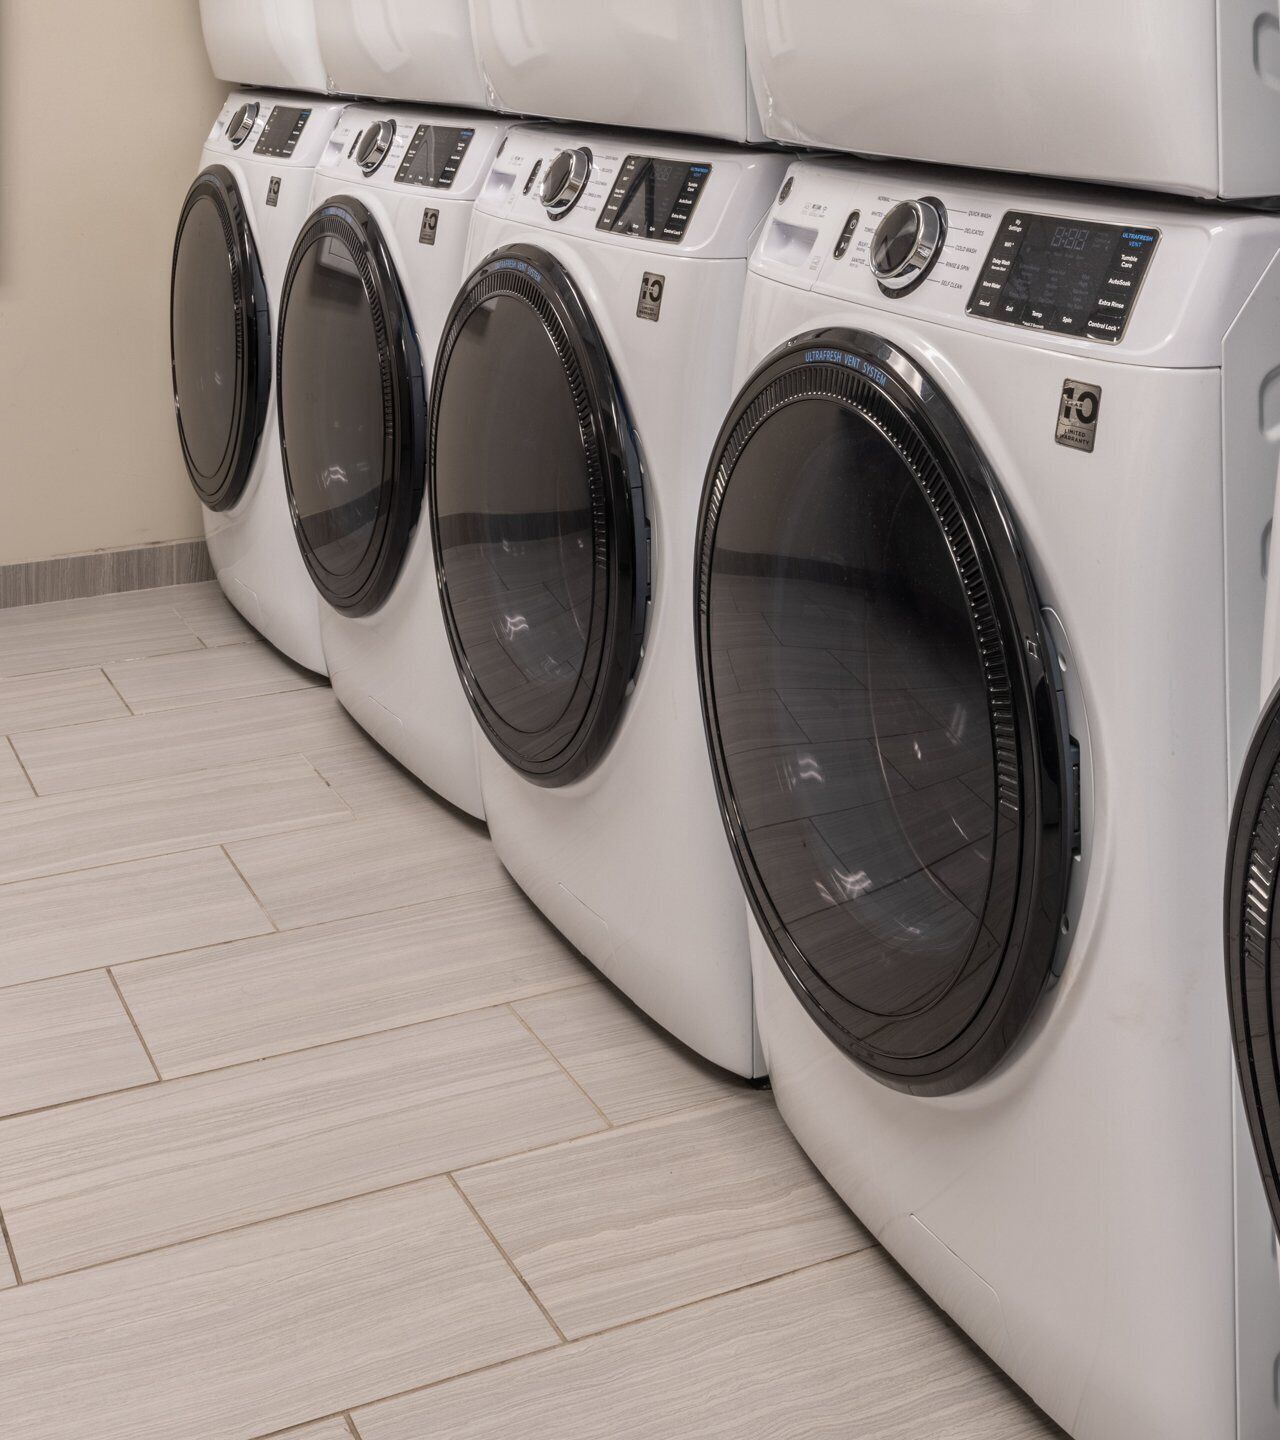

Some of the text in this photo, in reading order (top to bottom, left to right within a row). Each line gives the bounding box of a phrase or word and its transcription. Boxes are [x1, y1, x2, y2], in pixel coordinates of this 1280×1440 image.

[1122, 232, 1153, 242] ULTRAFRESH
[1121, 254, 1138, 262] Tumble
[1121, 261, 1132, 269] Care
[1108, 278, 1131, 287] AutoSoak
[642, 277, 663, 303] 10
[1087, 320, 1117, 332] Control Lock
[805, 350, 887, 386] ULTRAFRESH VENT SYSTEM
[1063, 387, 1098, 424] 10
[1065, 429, 1086, 438] LIMITED
